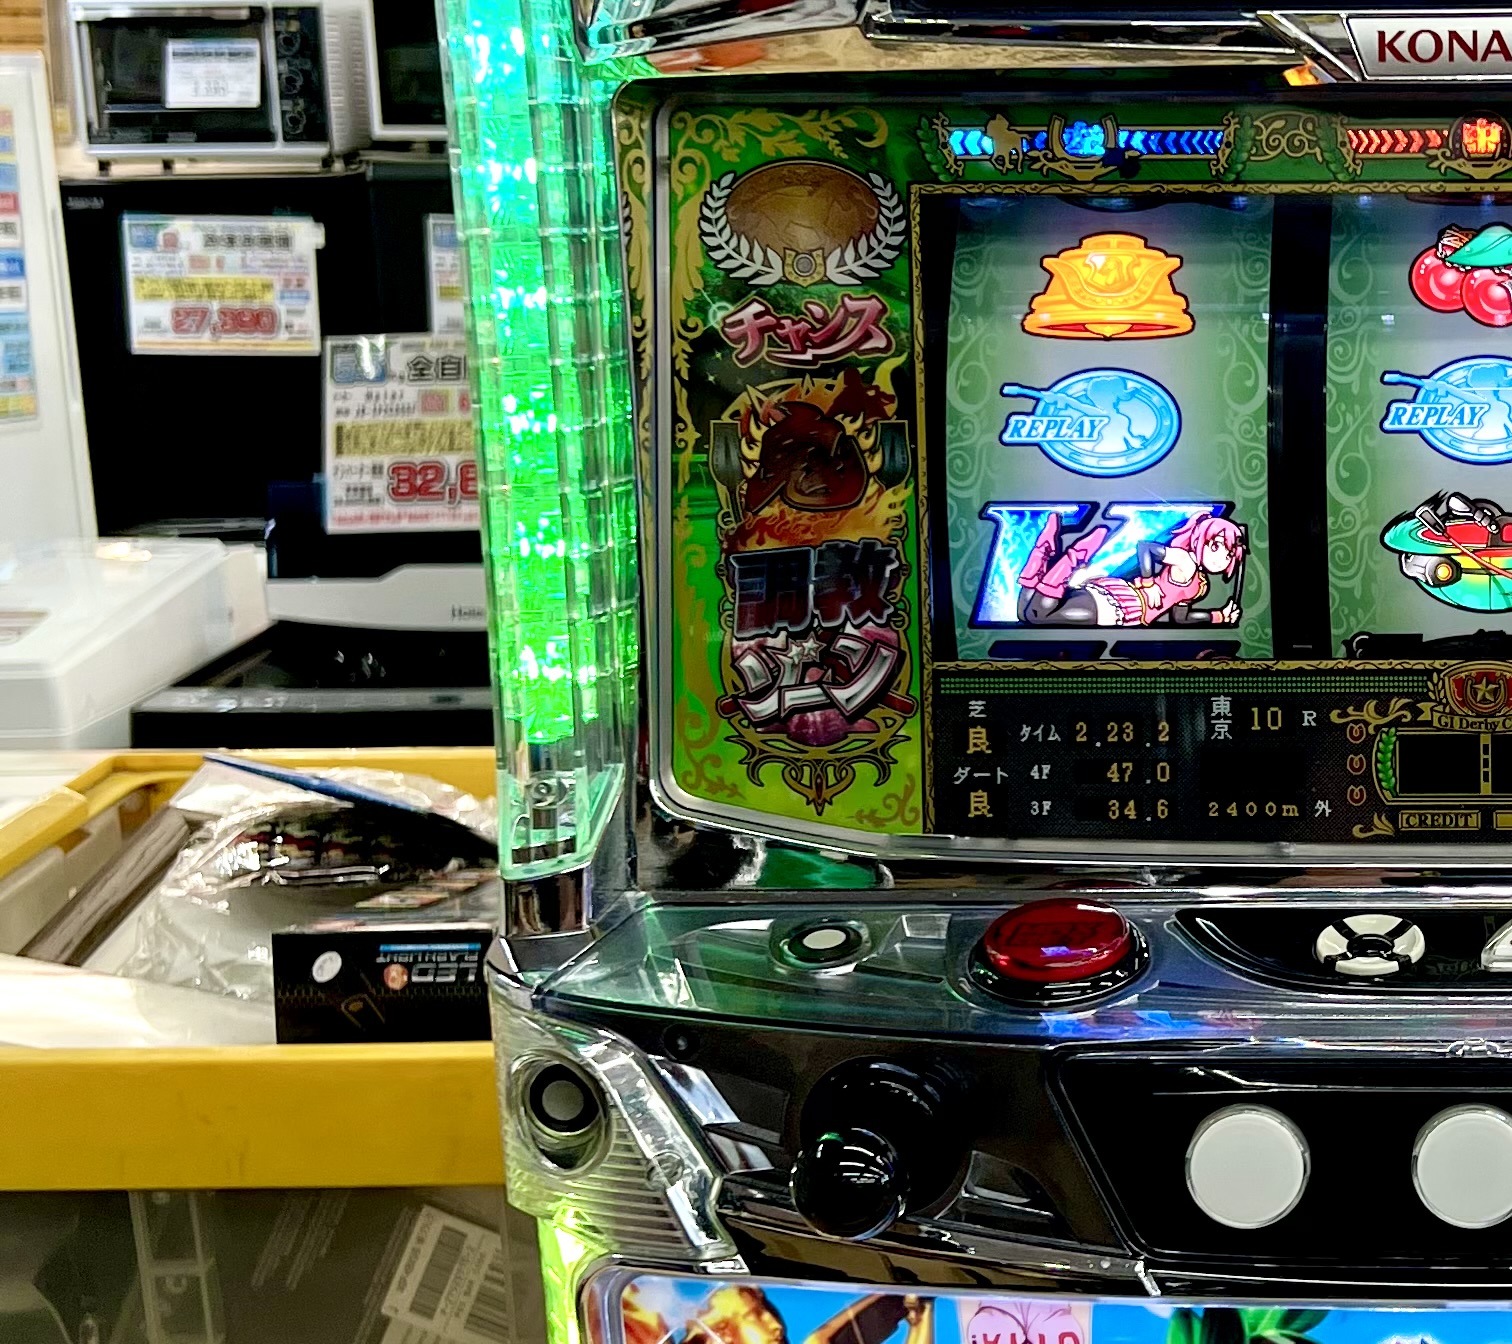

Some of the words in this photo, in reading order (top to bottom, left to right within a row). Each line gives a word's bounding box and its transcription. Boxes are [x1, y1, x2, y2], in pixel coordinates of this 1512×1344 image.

[724, 296, 894, 365] チャンス
[407, 355, 467, 383] 全自
[1390, 406, 1484, 427] REPLAY
[1007, 419, 1103, 441] REPLAY
[732, 540, 899, 638] 調教
[734, 635, 899, 723] ゾーン
[968, 700, 987, 719] 芝
[1211, 696, 1233, 741] 東京
[1250, 706, 1282, 731] 10
[1301, 711, 1317, 727] R
[1020, 723, 1061, 743] タイム
[1459, 716, 1500, 731] Derby
[967, 725, 991, 755] 良
[953, 766, 1009, 784] ダート
[1029, 764, 1051, 780] 4F
[968, 790, 992, 818] 良
[1030, 800, 1051, 816] 3F
[1313, 799, 1333, 818] 外
[1404, 813, 1473, 827] CREDIT
[411, 962, 478, 983] LED
